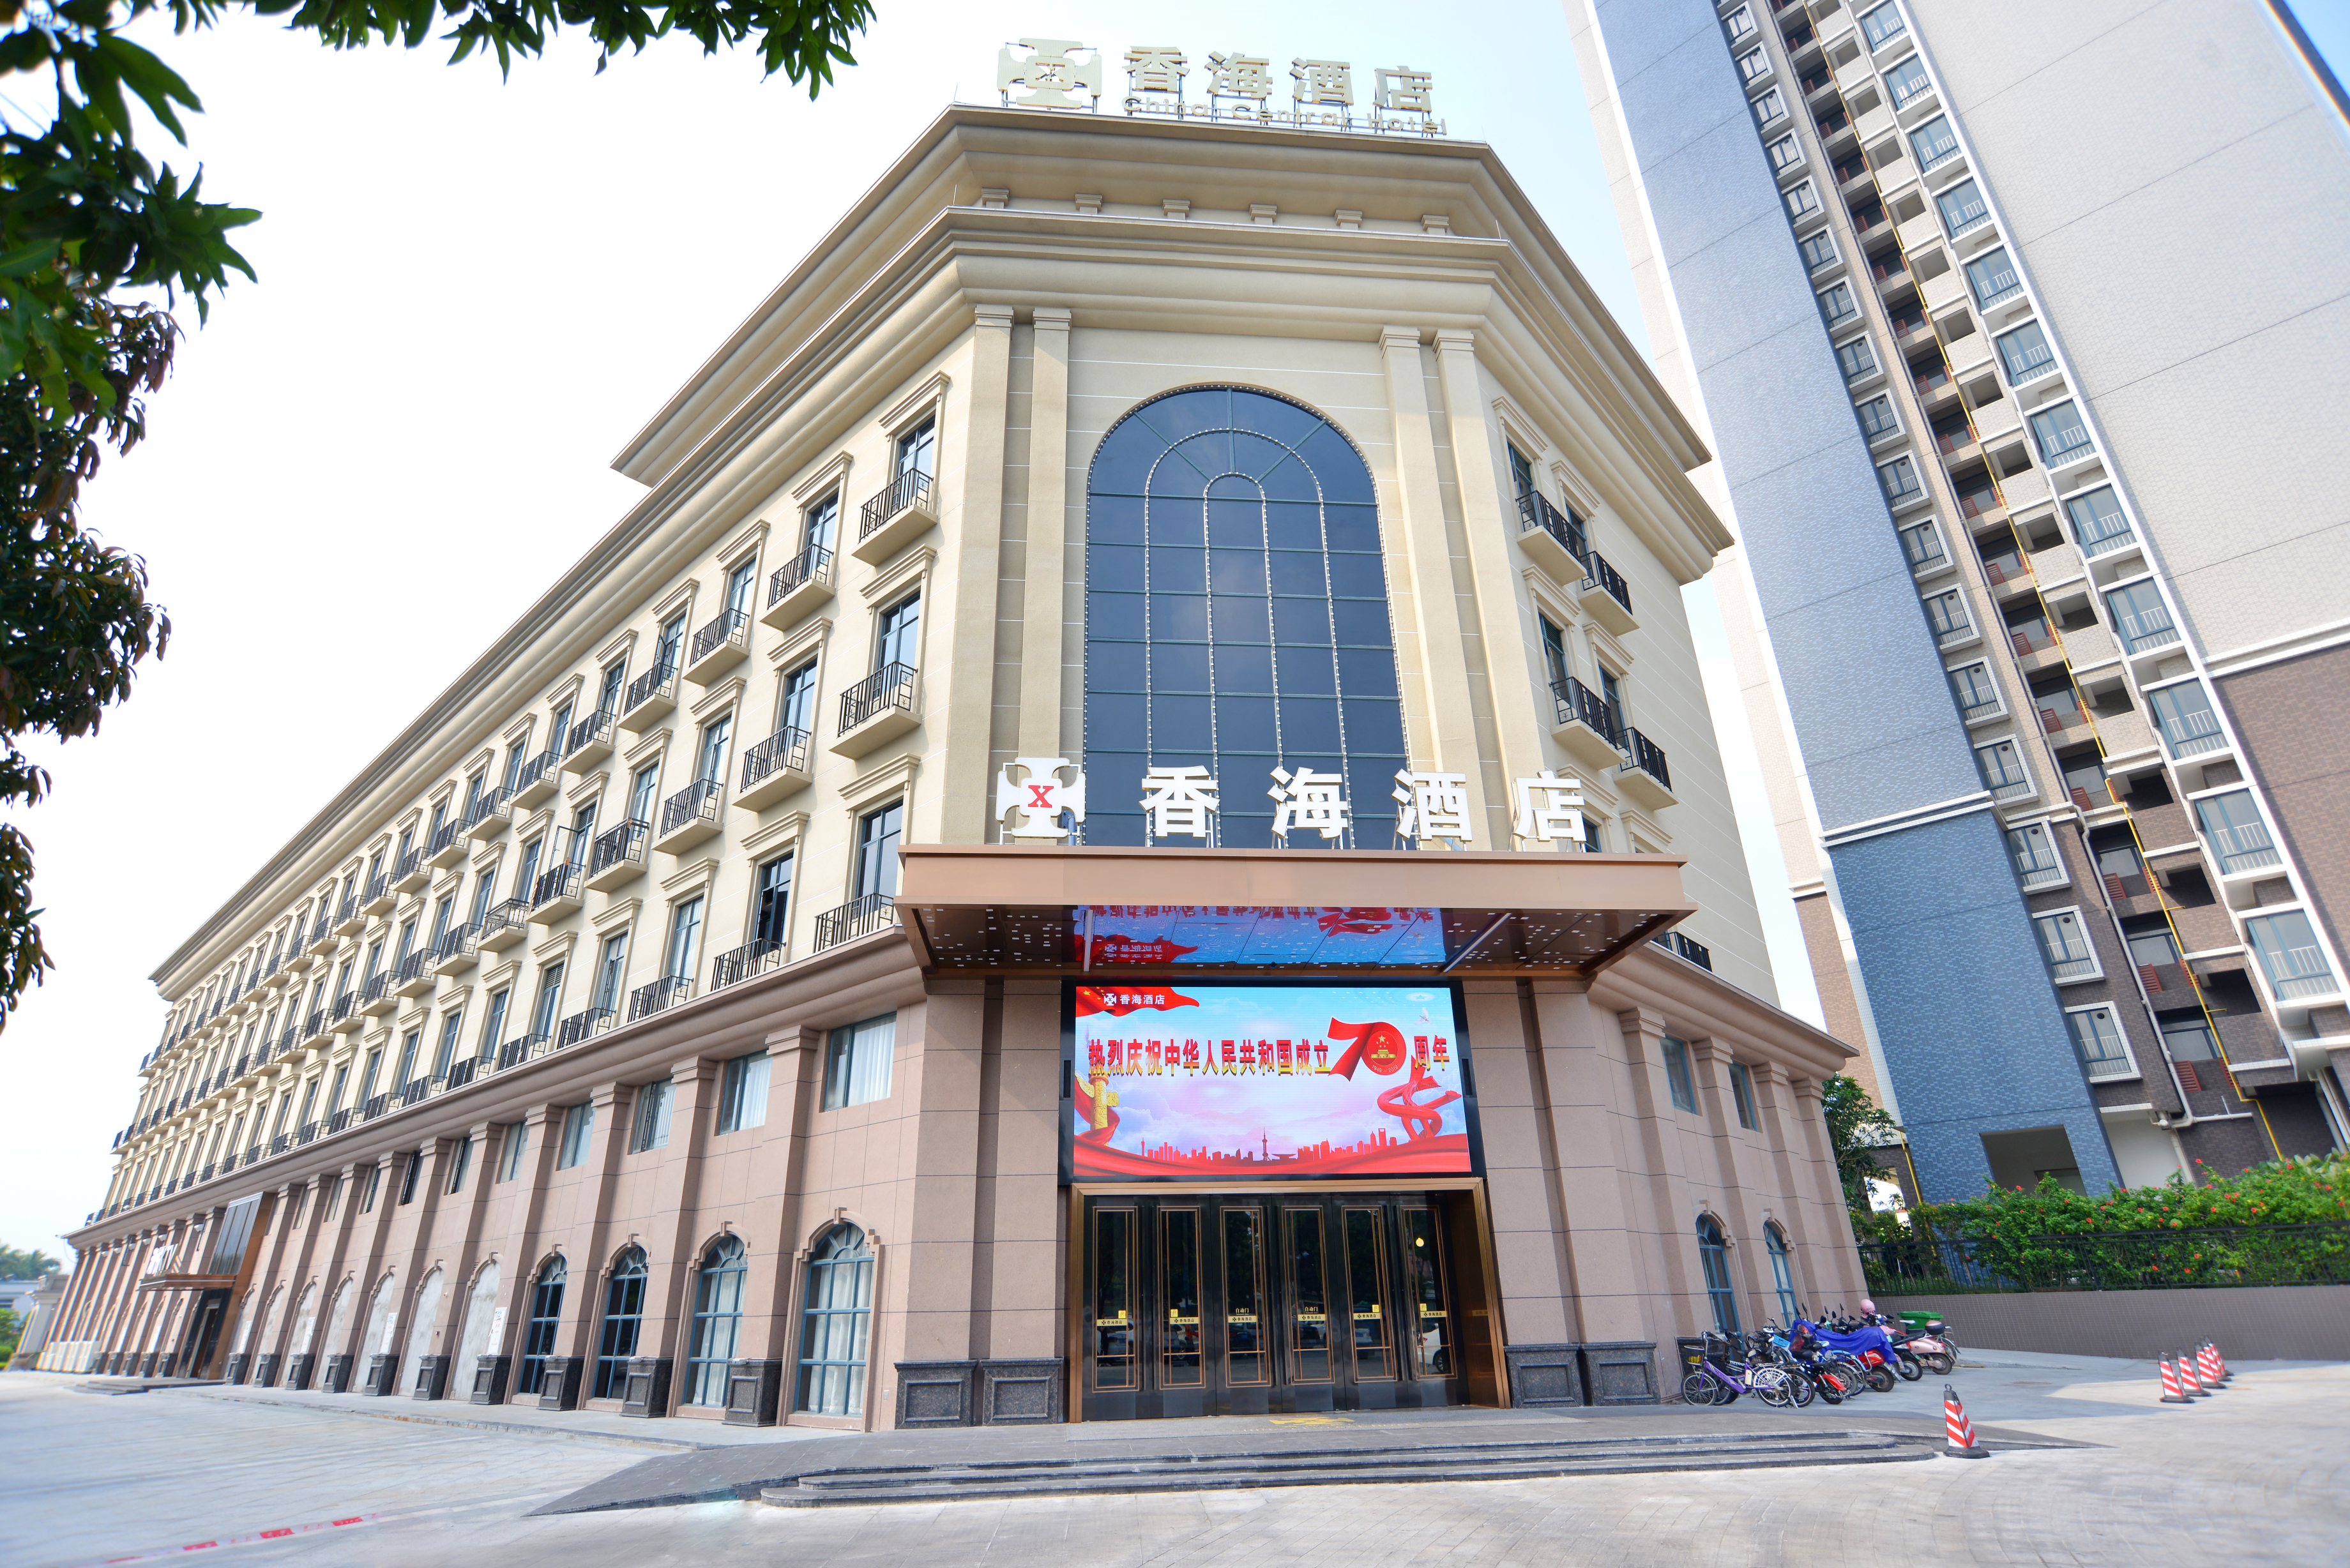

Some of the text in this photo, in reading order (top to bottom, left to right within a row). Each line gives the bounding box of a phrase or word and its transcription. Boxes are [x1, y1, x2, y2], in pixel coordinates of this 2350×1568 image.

[1122, 46, 1433, 113] 香海酒店
[1122, 95, 1447, 135] China Central Hotel
[1027, 785, 1054, 808] X
[1139, 765, 1586, 843] 香海酒店
[1119, 994, 1165, 1005] 香海酒店
[1371, 1064, 1382, 1073] 1949
[1388, 1064, 1399, 1073] 2019
